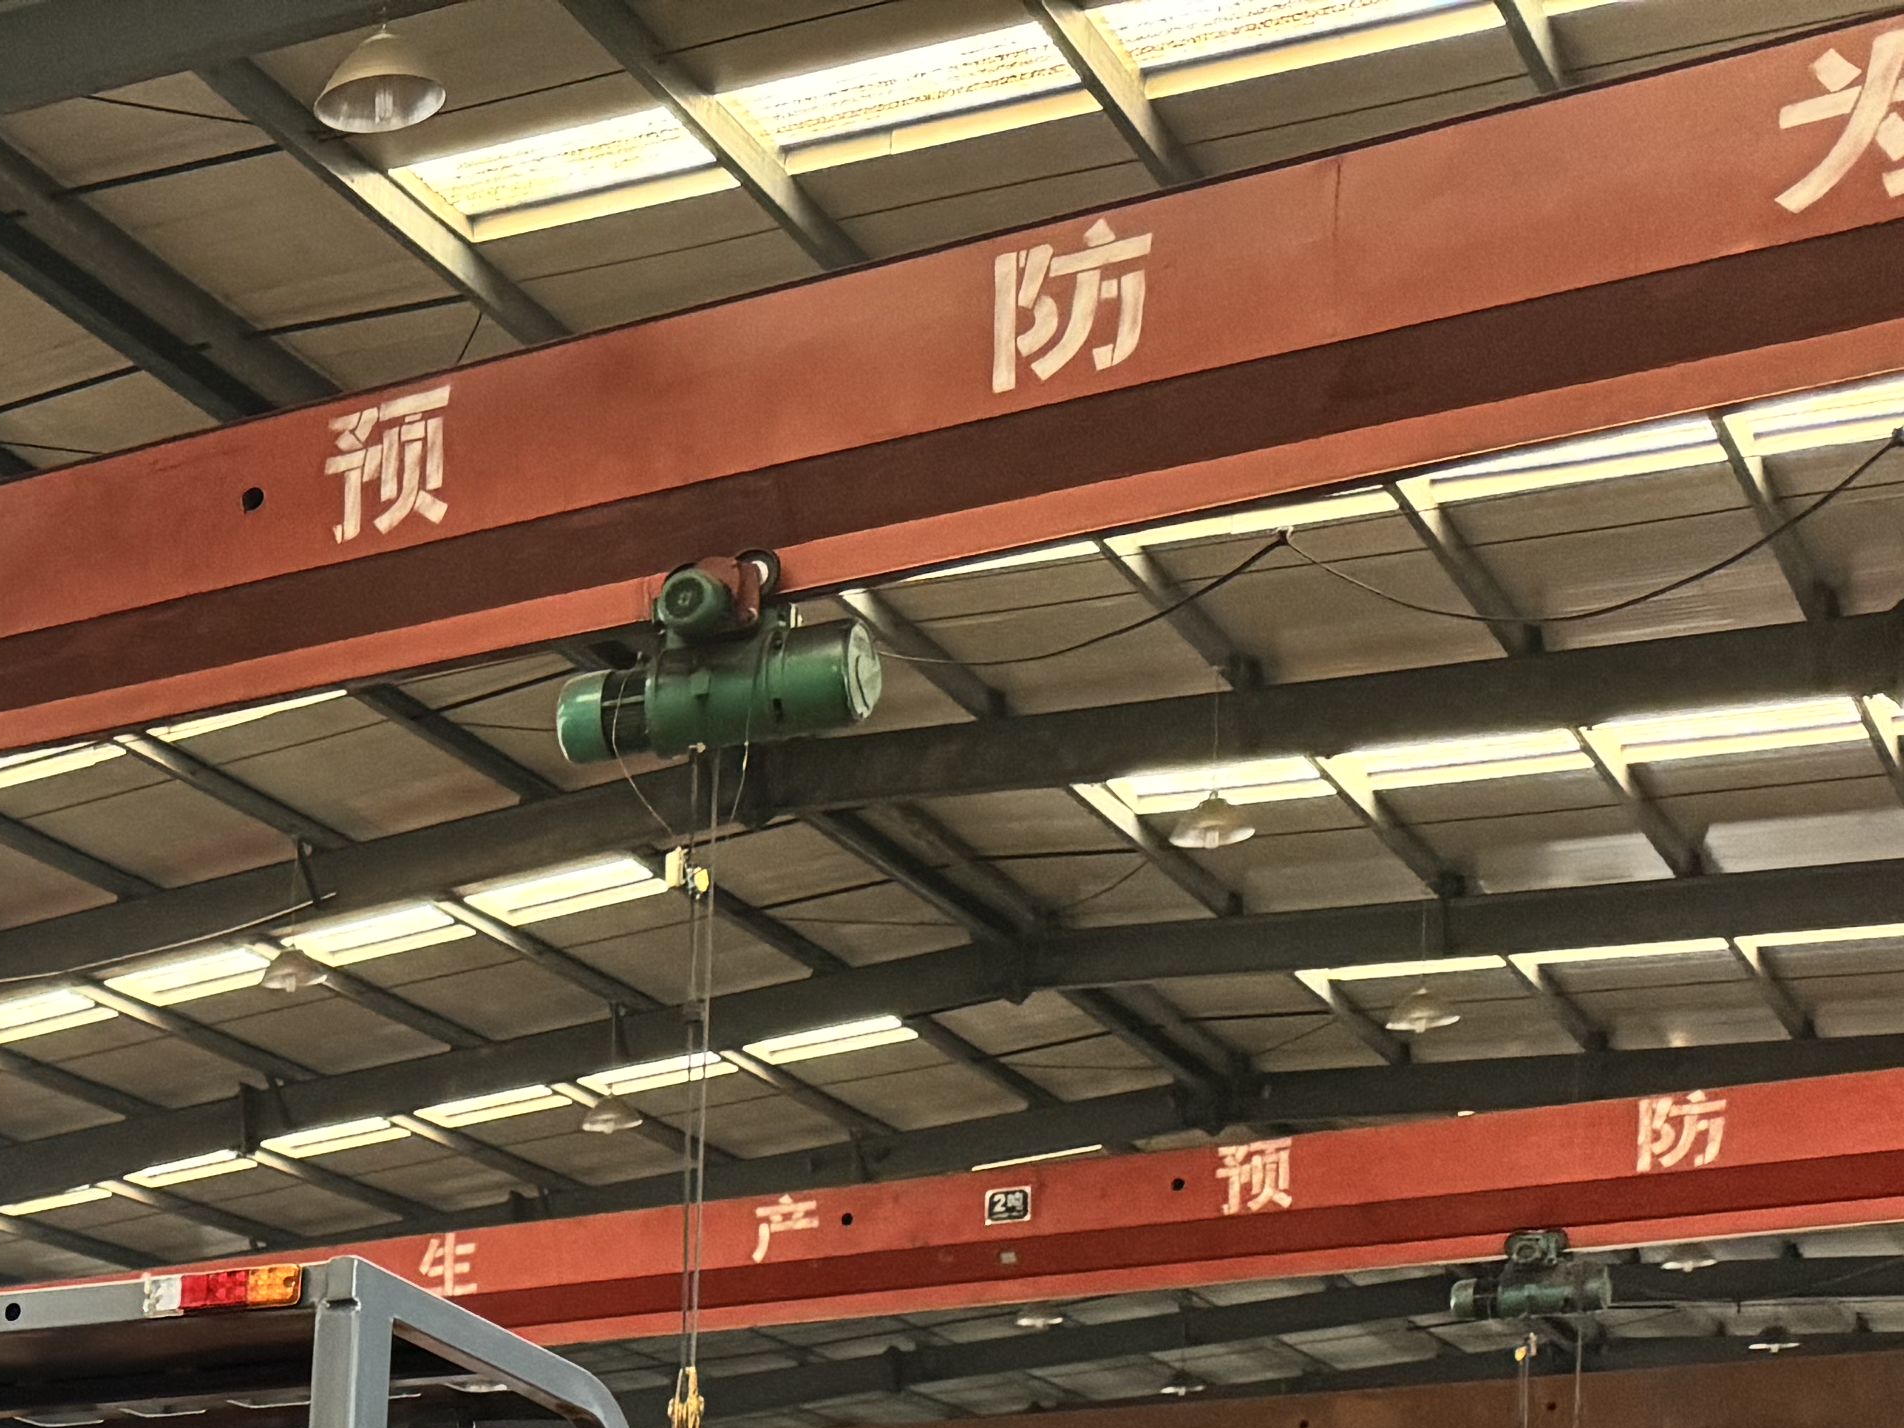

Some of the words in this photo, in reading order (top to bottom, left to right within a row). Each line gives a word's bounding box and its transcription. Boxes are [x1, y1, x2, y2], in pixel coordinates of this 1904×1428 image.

[324, 384, 451, 545] 预
[992, 217, 1153, 394] 防
[419, 1231, 479, 1297] 生
[752, 1194, 820, 1264] 产
[1215, 1136, 1293, 1216] 预
[1636, 1089, 1727, 1173] 防
